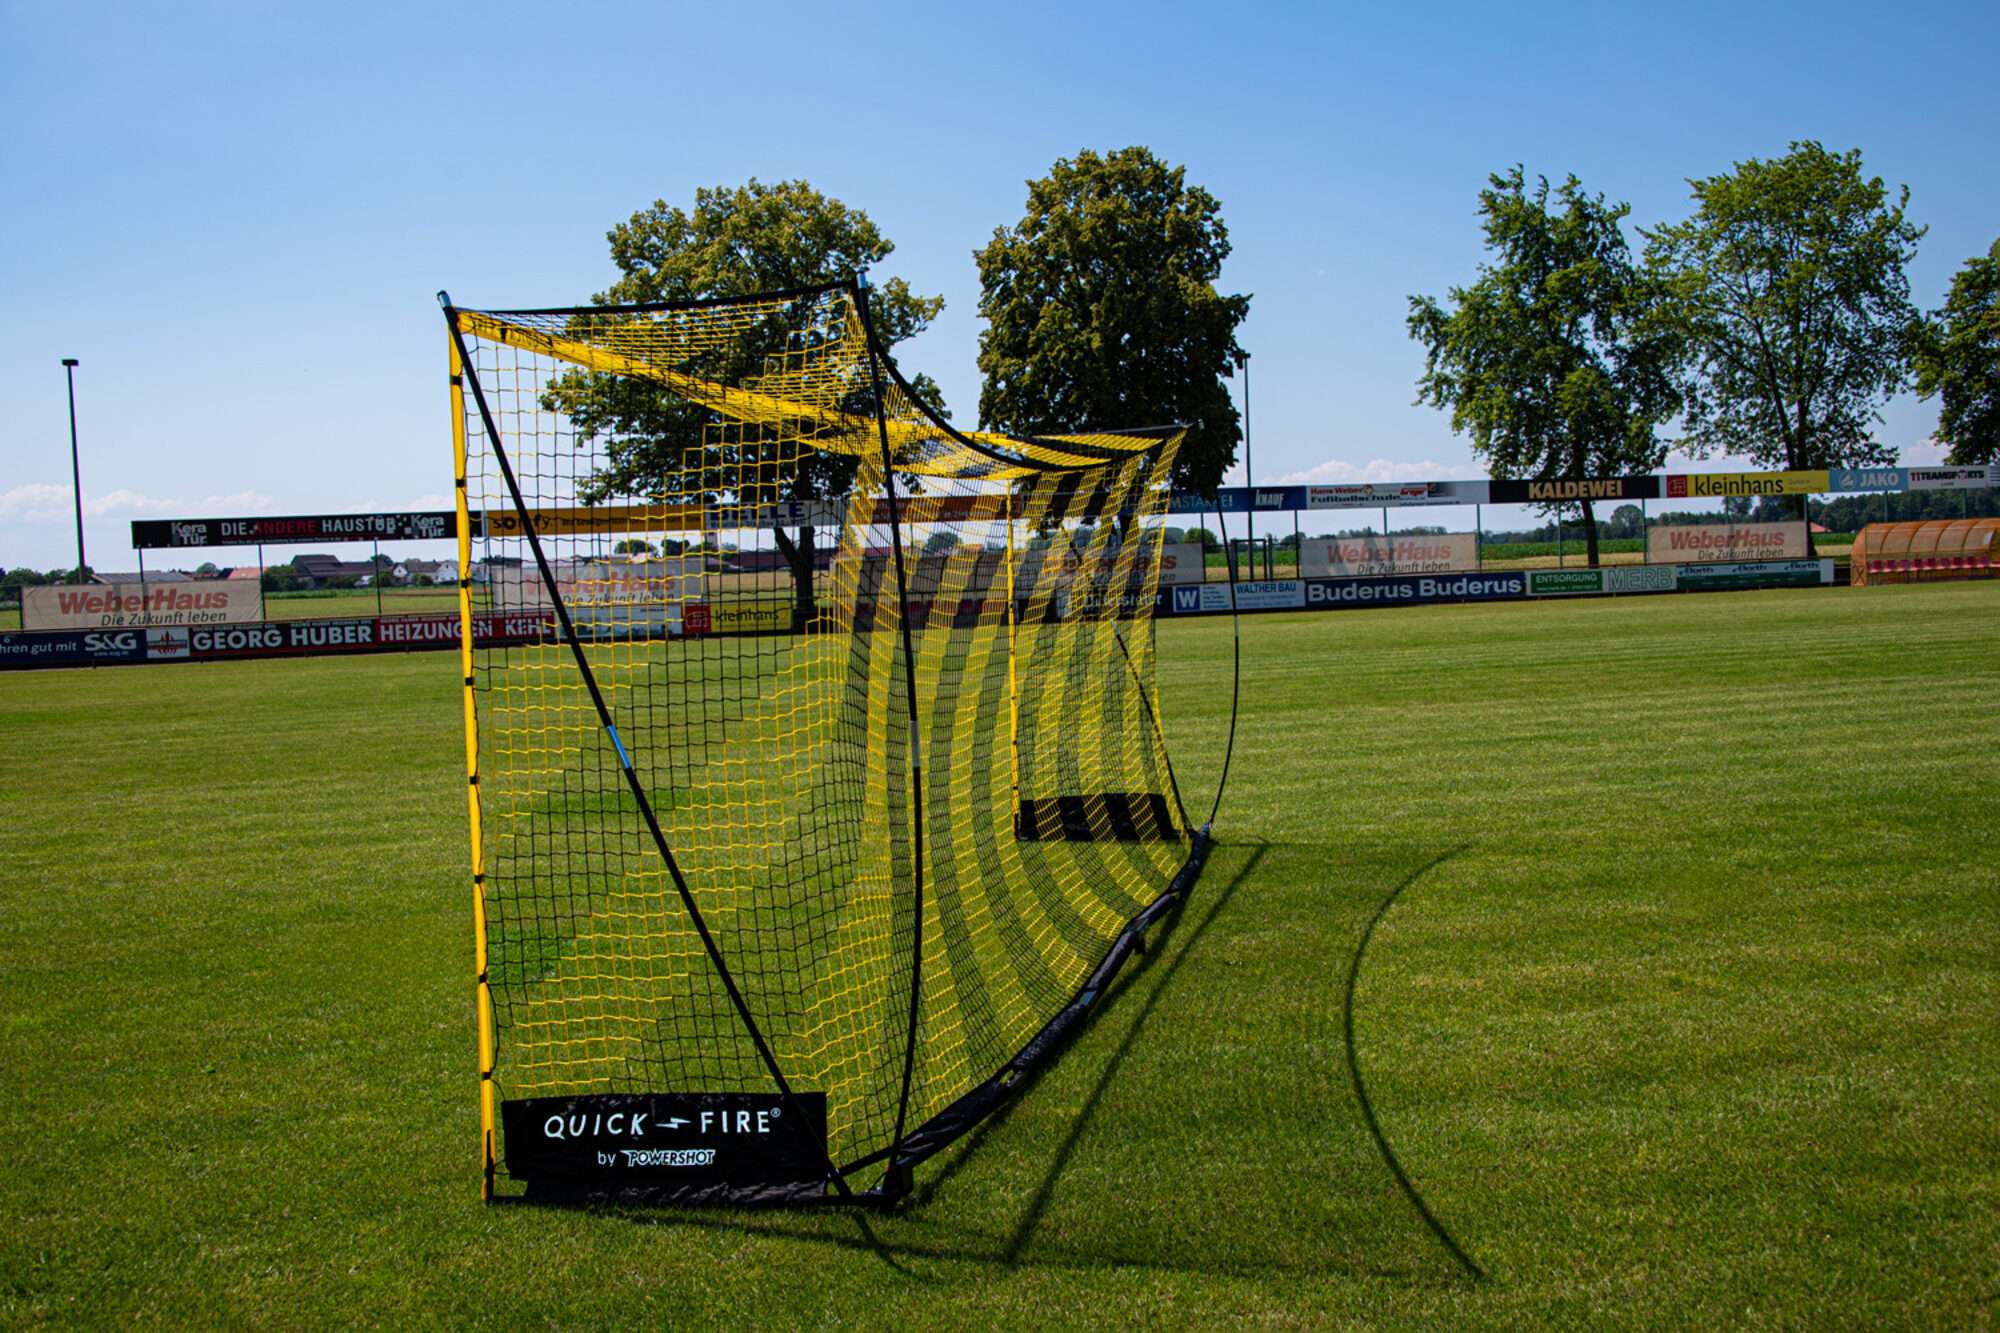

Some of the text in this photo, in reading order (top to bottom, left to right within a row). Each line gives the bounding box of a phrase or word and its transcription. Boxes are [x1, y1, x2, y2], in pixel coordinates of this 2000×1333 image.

[1695, 475, 1784, 496] kleinhans
[1859, 472, 1899, 488] JAKO
[1529, 480, 1623, 499] KALDEWEI
[171, 522, 207, 534] Kera
[221, 522, 248, 536] DIE
[410, 514, 445, 528] Kera
[1670, 528, 1785, 549] WeberHaus
[1327, 541, 1452, 564] WeberHaus
[1698, 549, 1714, 560] Die
[1357, 559, 1450, 575] Die Zukunft leben
[1536, 572, 1598, 584] ENTSORGUNG
[1608, 567, 1673, 591] MERB
[1236, 582, 1297, 594] WALTHER BAU
[1308, 582, 1414, 602] Buderus
[1419, 577, 1522, 598] Buderus
[58, 588, 229, 615] WeberHaus
[1178, 590, 1197, 608] W
[101, 610, 227, 626] Die Zukunft leben
[84, 632, 137, 652] S&G
[193, 629, 283, 650] GEORG
[290, 625, 372, 646] HUBER
[505, 618, 551, 636] KEHL
[31, 641, 53, 656] gut
[55, 641, 77, 652] mit
[544, 1113, 648, 1140] QUICK
[597, 1148, 716, 1167] by POWERSHOT
